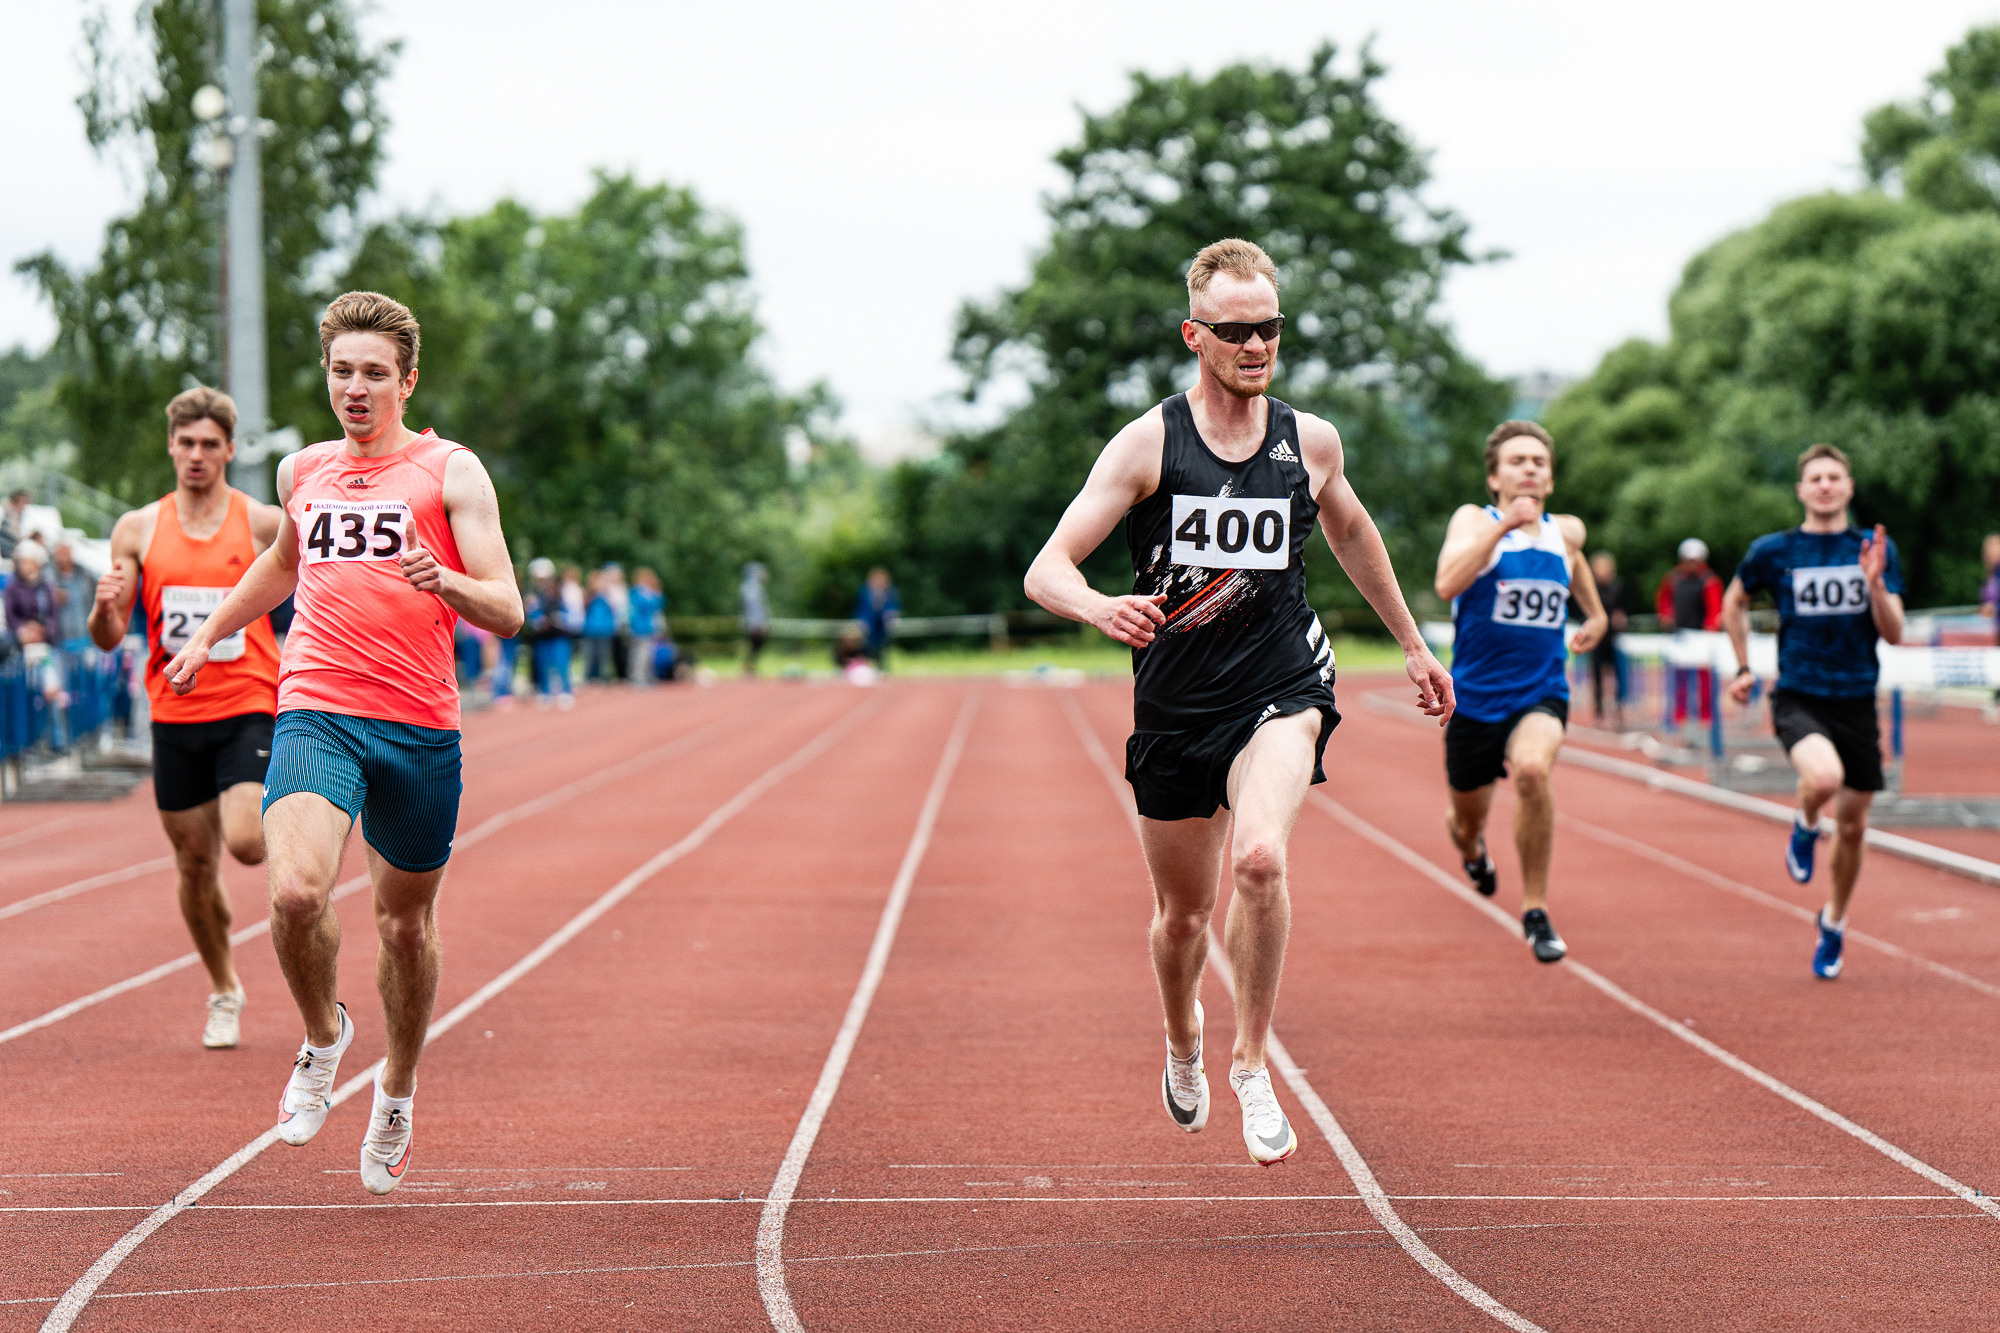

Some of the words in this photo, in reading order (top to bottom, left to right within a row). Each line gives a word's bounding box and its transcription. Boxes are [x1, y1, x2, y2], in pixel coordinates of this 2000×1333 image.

[1269, 451, 1299, 463] adidas
[313, 502, 348, 511] АКАДЕМИЯ
[307, 512, 402, 559] 435
[1175, 508, 1284, 554] 400
[1502, 588, 1561, 623] 399
[1800, 578, 1865, 608] 403
